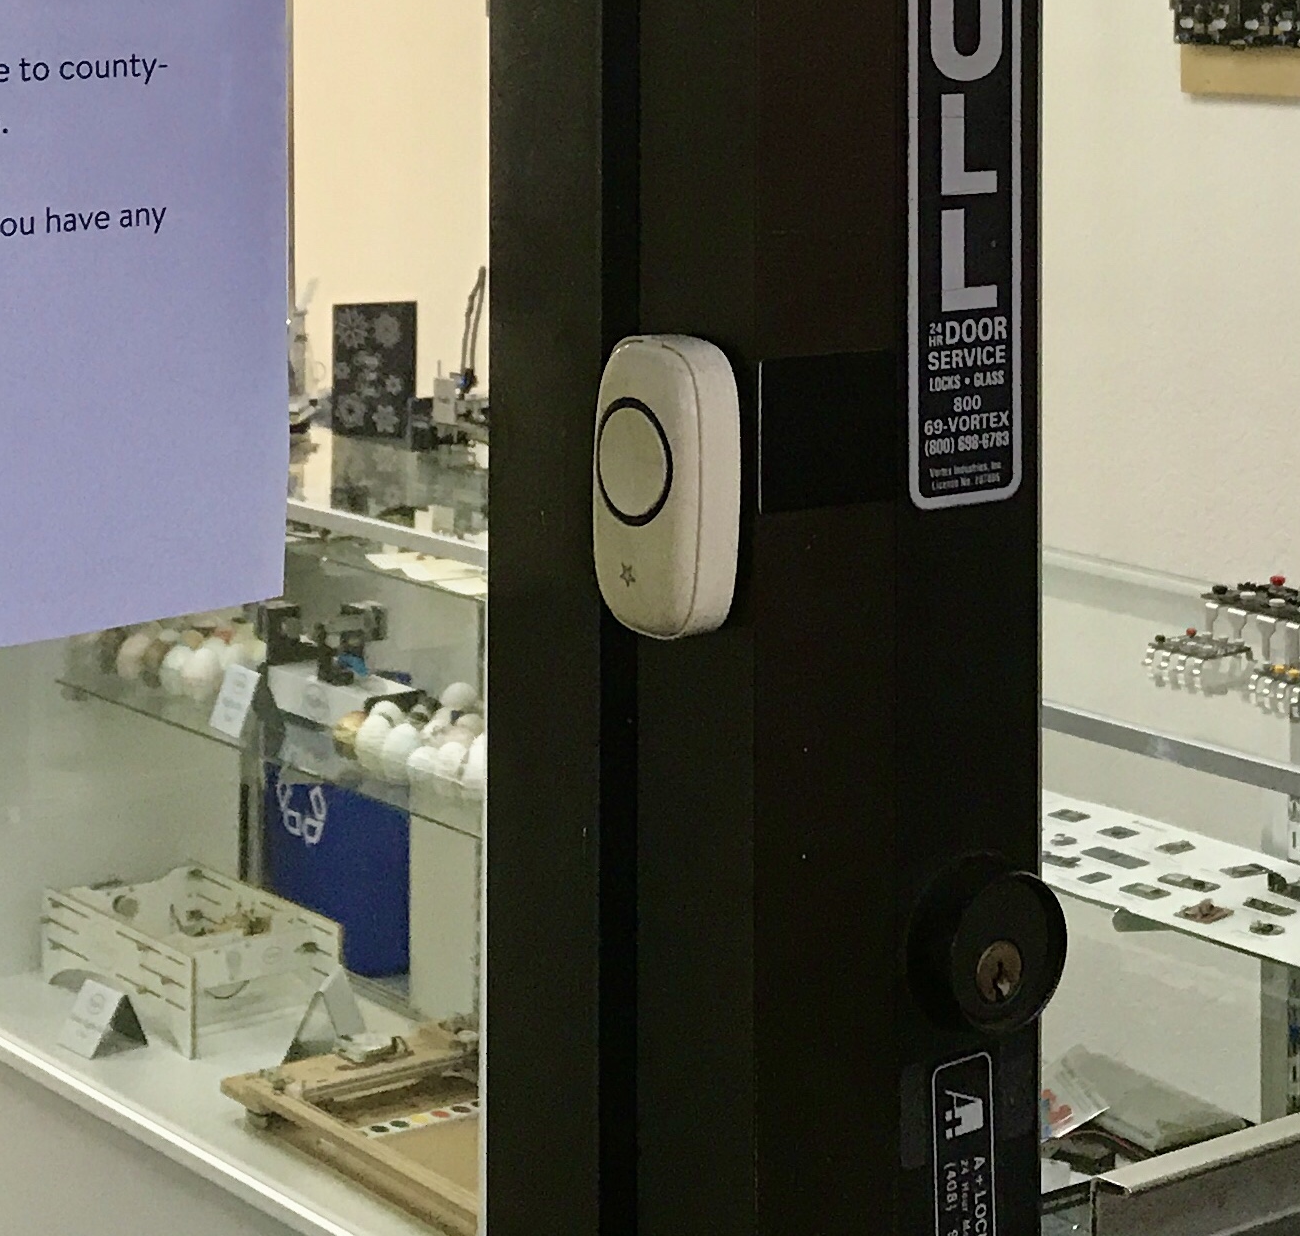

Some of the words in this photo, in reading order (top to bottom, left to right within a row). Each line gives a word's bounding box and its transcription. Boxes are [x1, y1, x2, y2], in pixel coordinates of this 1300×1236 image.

[19, 58, 50, 82] to
[59, 54, 168, 85] county-
[46, 207, 110, 233] have
[120, 207, 166, 234] any
[929, 323, 942, 334] 24
[946, 316, 1007, 345] DOOR
[929, 335, 943, 347] HR
[928, 345, 1006, 370] SERVICE
[929, 374, 961, 392] LOCKS
[974, 371, 1004, 387] GLASS
[953, 395, 981, 412] 800
[924, 411, 1009, 435] 69-VORTEX
[924, 438, 954, 456] (800)
[974, 1190, 987, 1236] LOC
